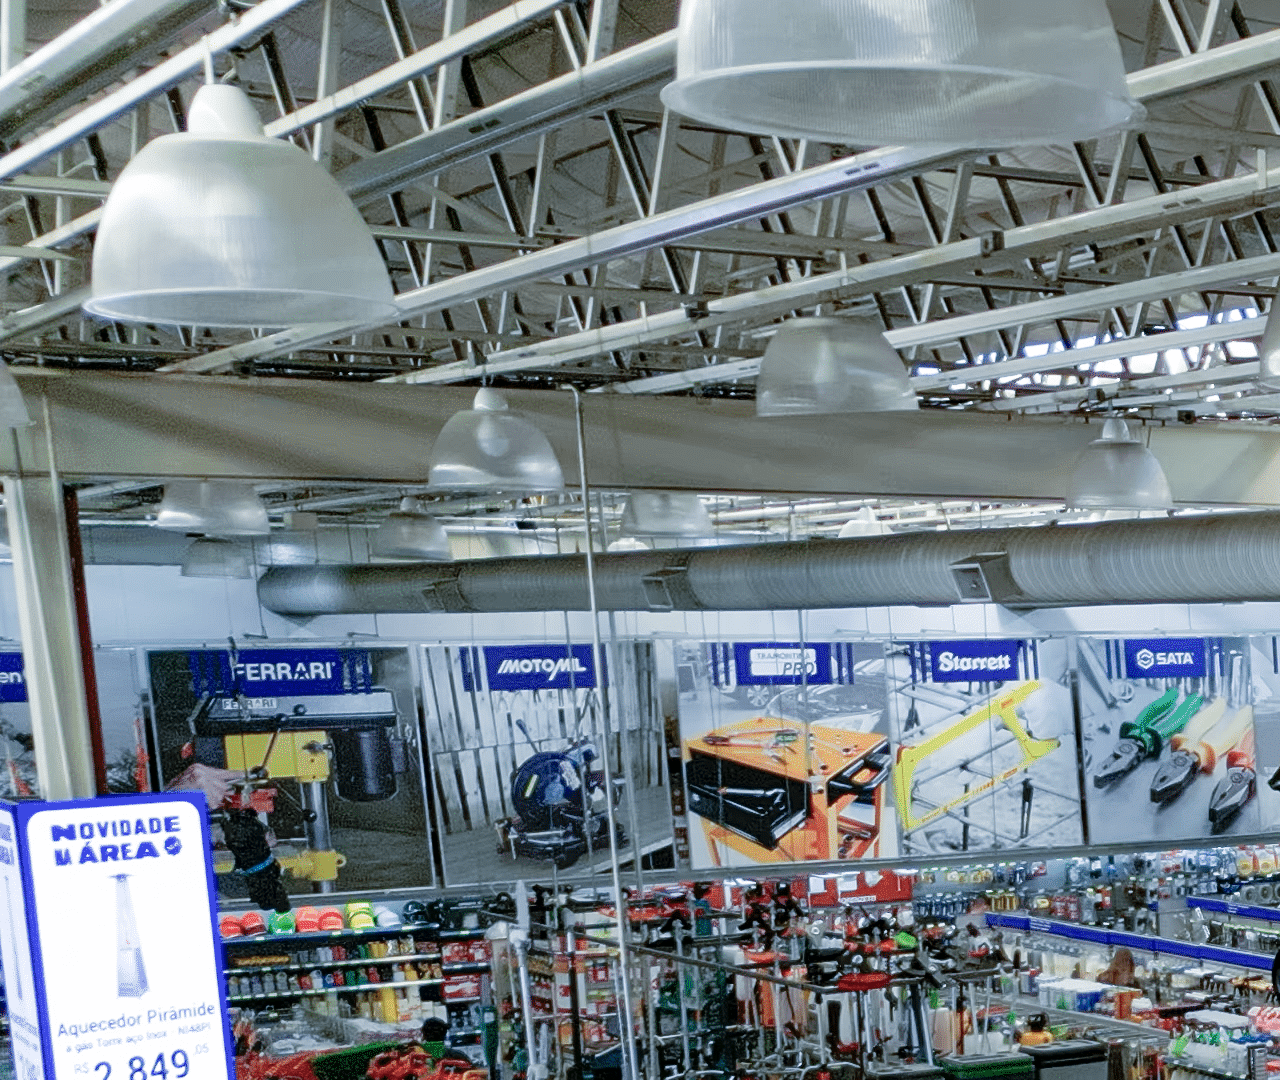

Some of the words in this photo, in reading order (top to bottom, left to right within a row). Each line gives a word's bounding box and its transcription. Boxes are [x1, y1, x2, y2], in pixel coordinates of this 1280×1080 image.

[939, 651, 1010, 674] Starrett
[1156, 652, 1194, 665] SATA
[233, 662, 333, 681] FERRARI
[51, 815, 182, 843] NOVIDADE
[78, 841, 161, 866] ÁREA
[57, 1013, 142, 1038] Aquecedor
[147, 1002, 216, 1024] Pirâmide
